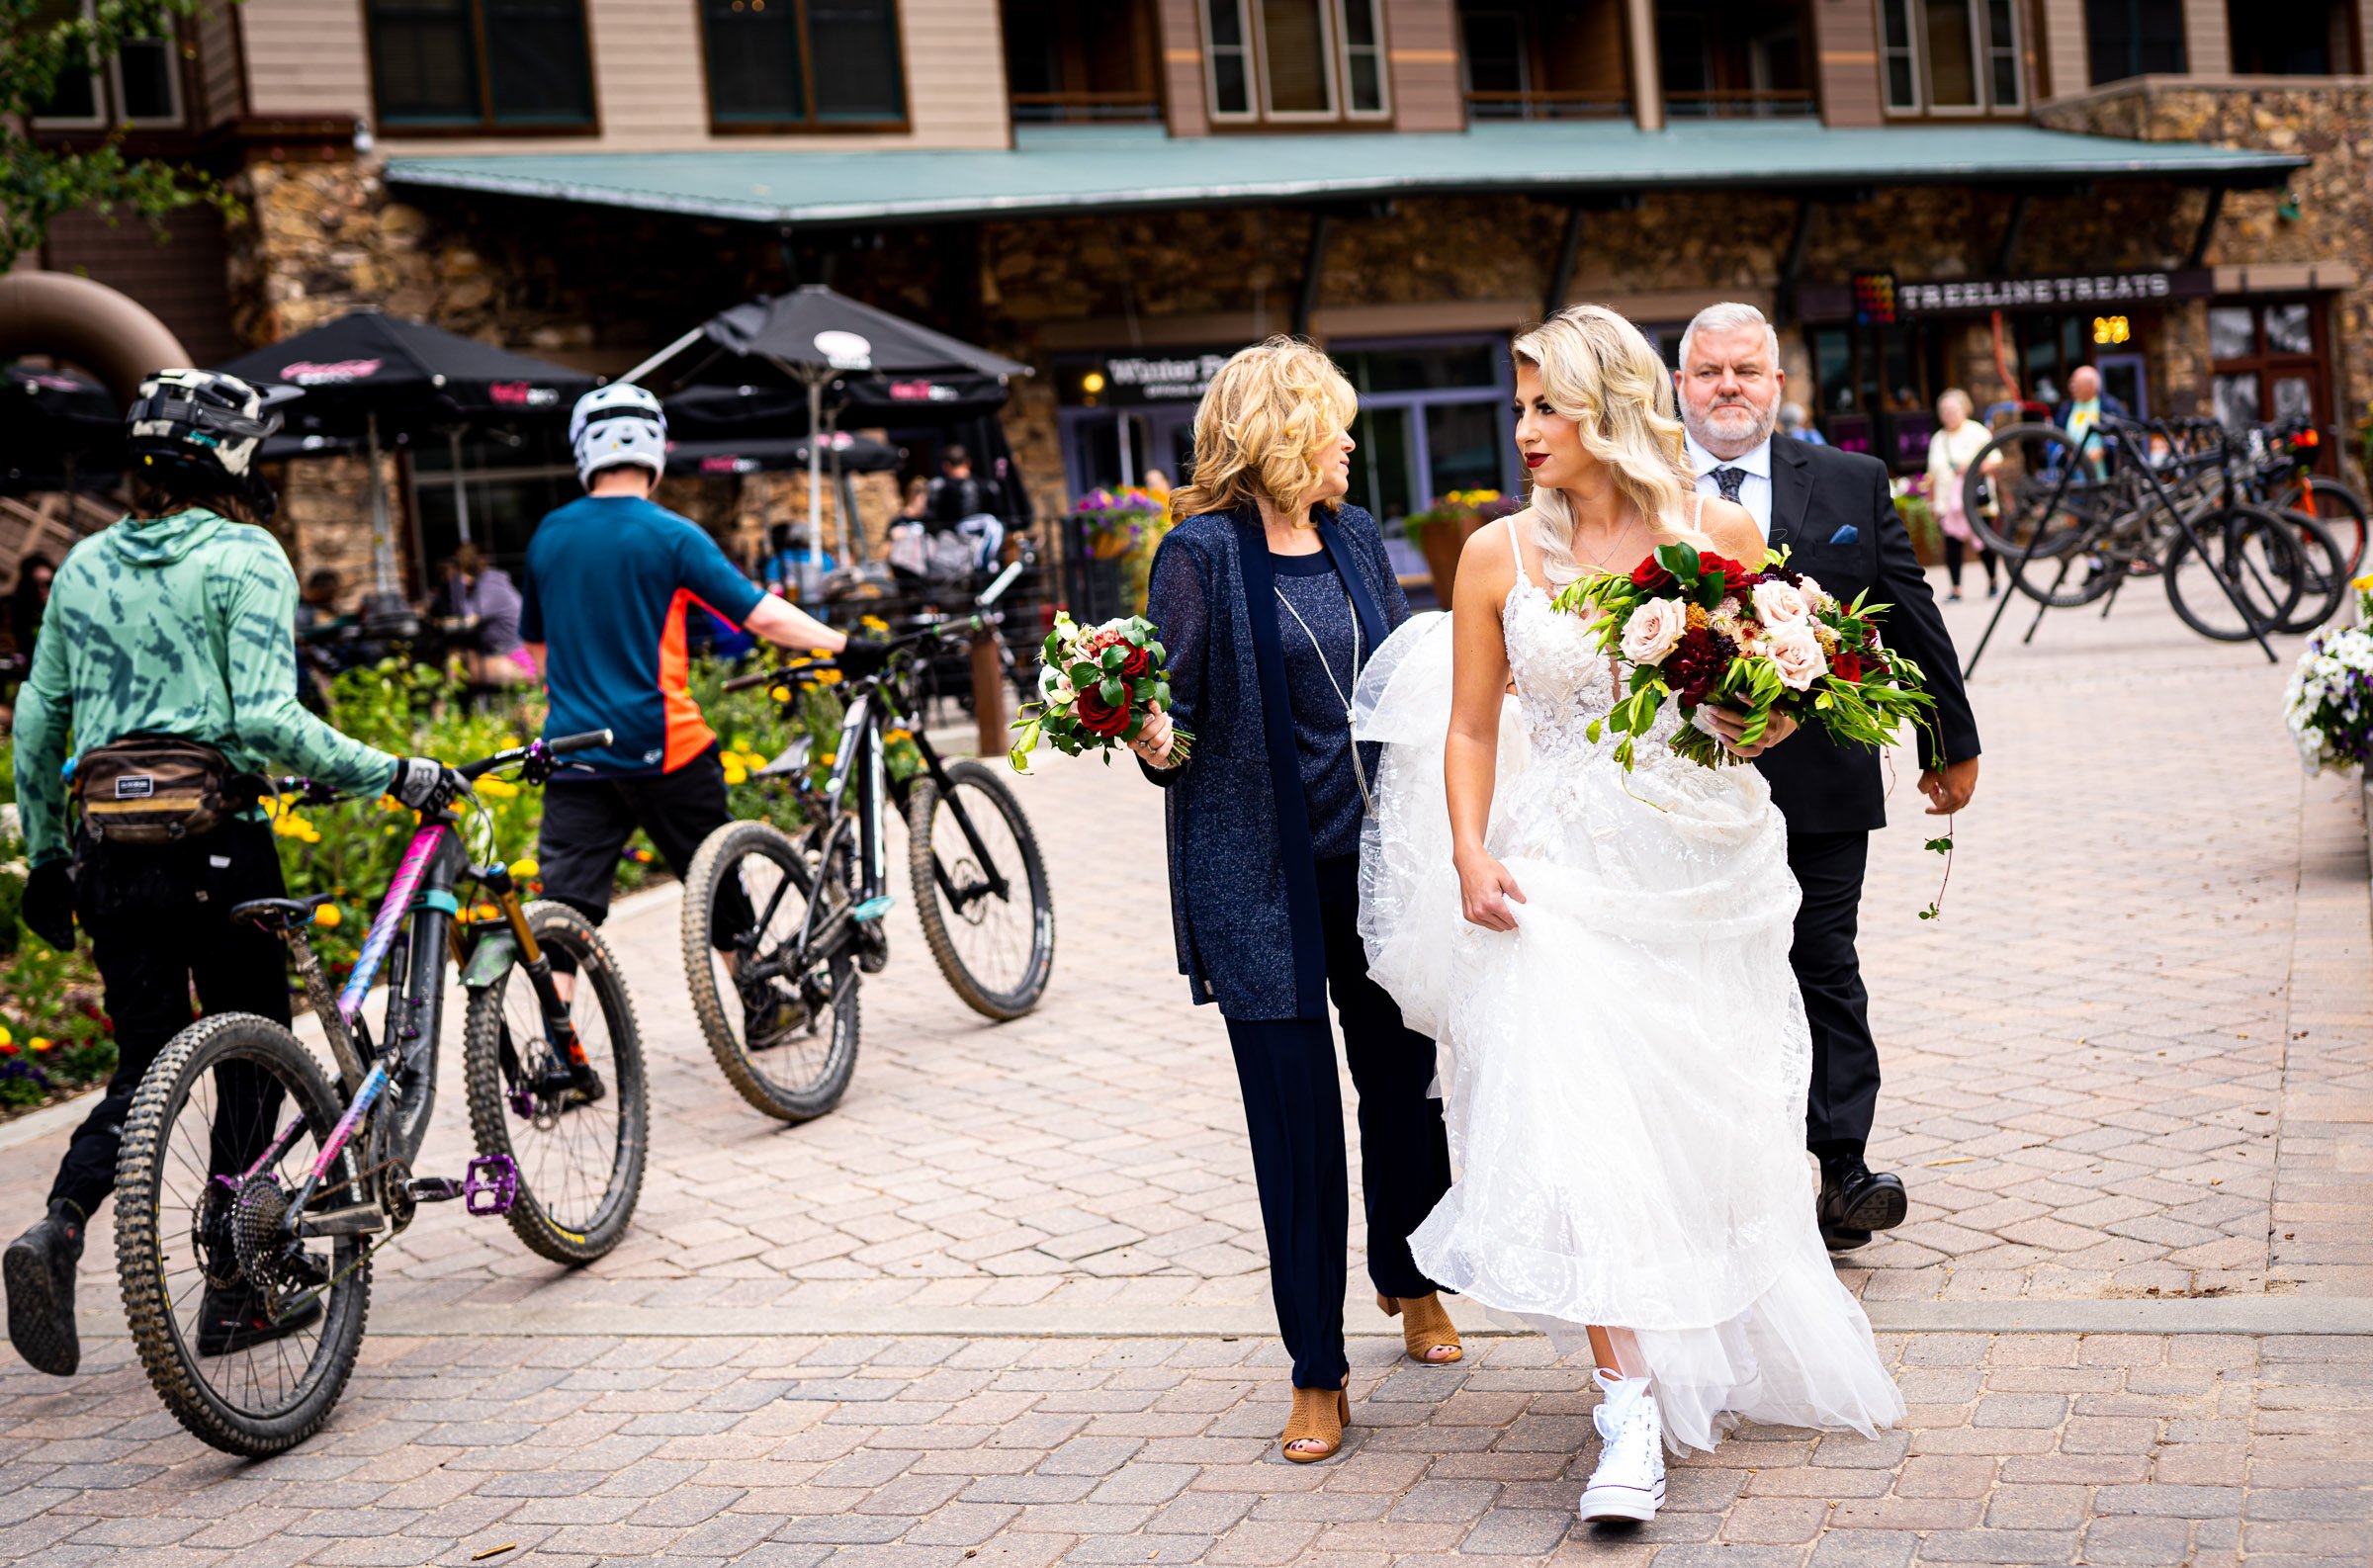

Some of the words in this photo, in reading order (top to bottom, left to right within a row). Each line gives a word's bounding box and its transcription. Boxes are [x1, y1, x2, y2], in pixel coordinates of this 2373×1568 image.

[1899, 277, 2051, 309] TREELINE
[2054, 273, 2170, 302] TREATS
[1107, 357, 1197, 385] Winter
